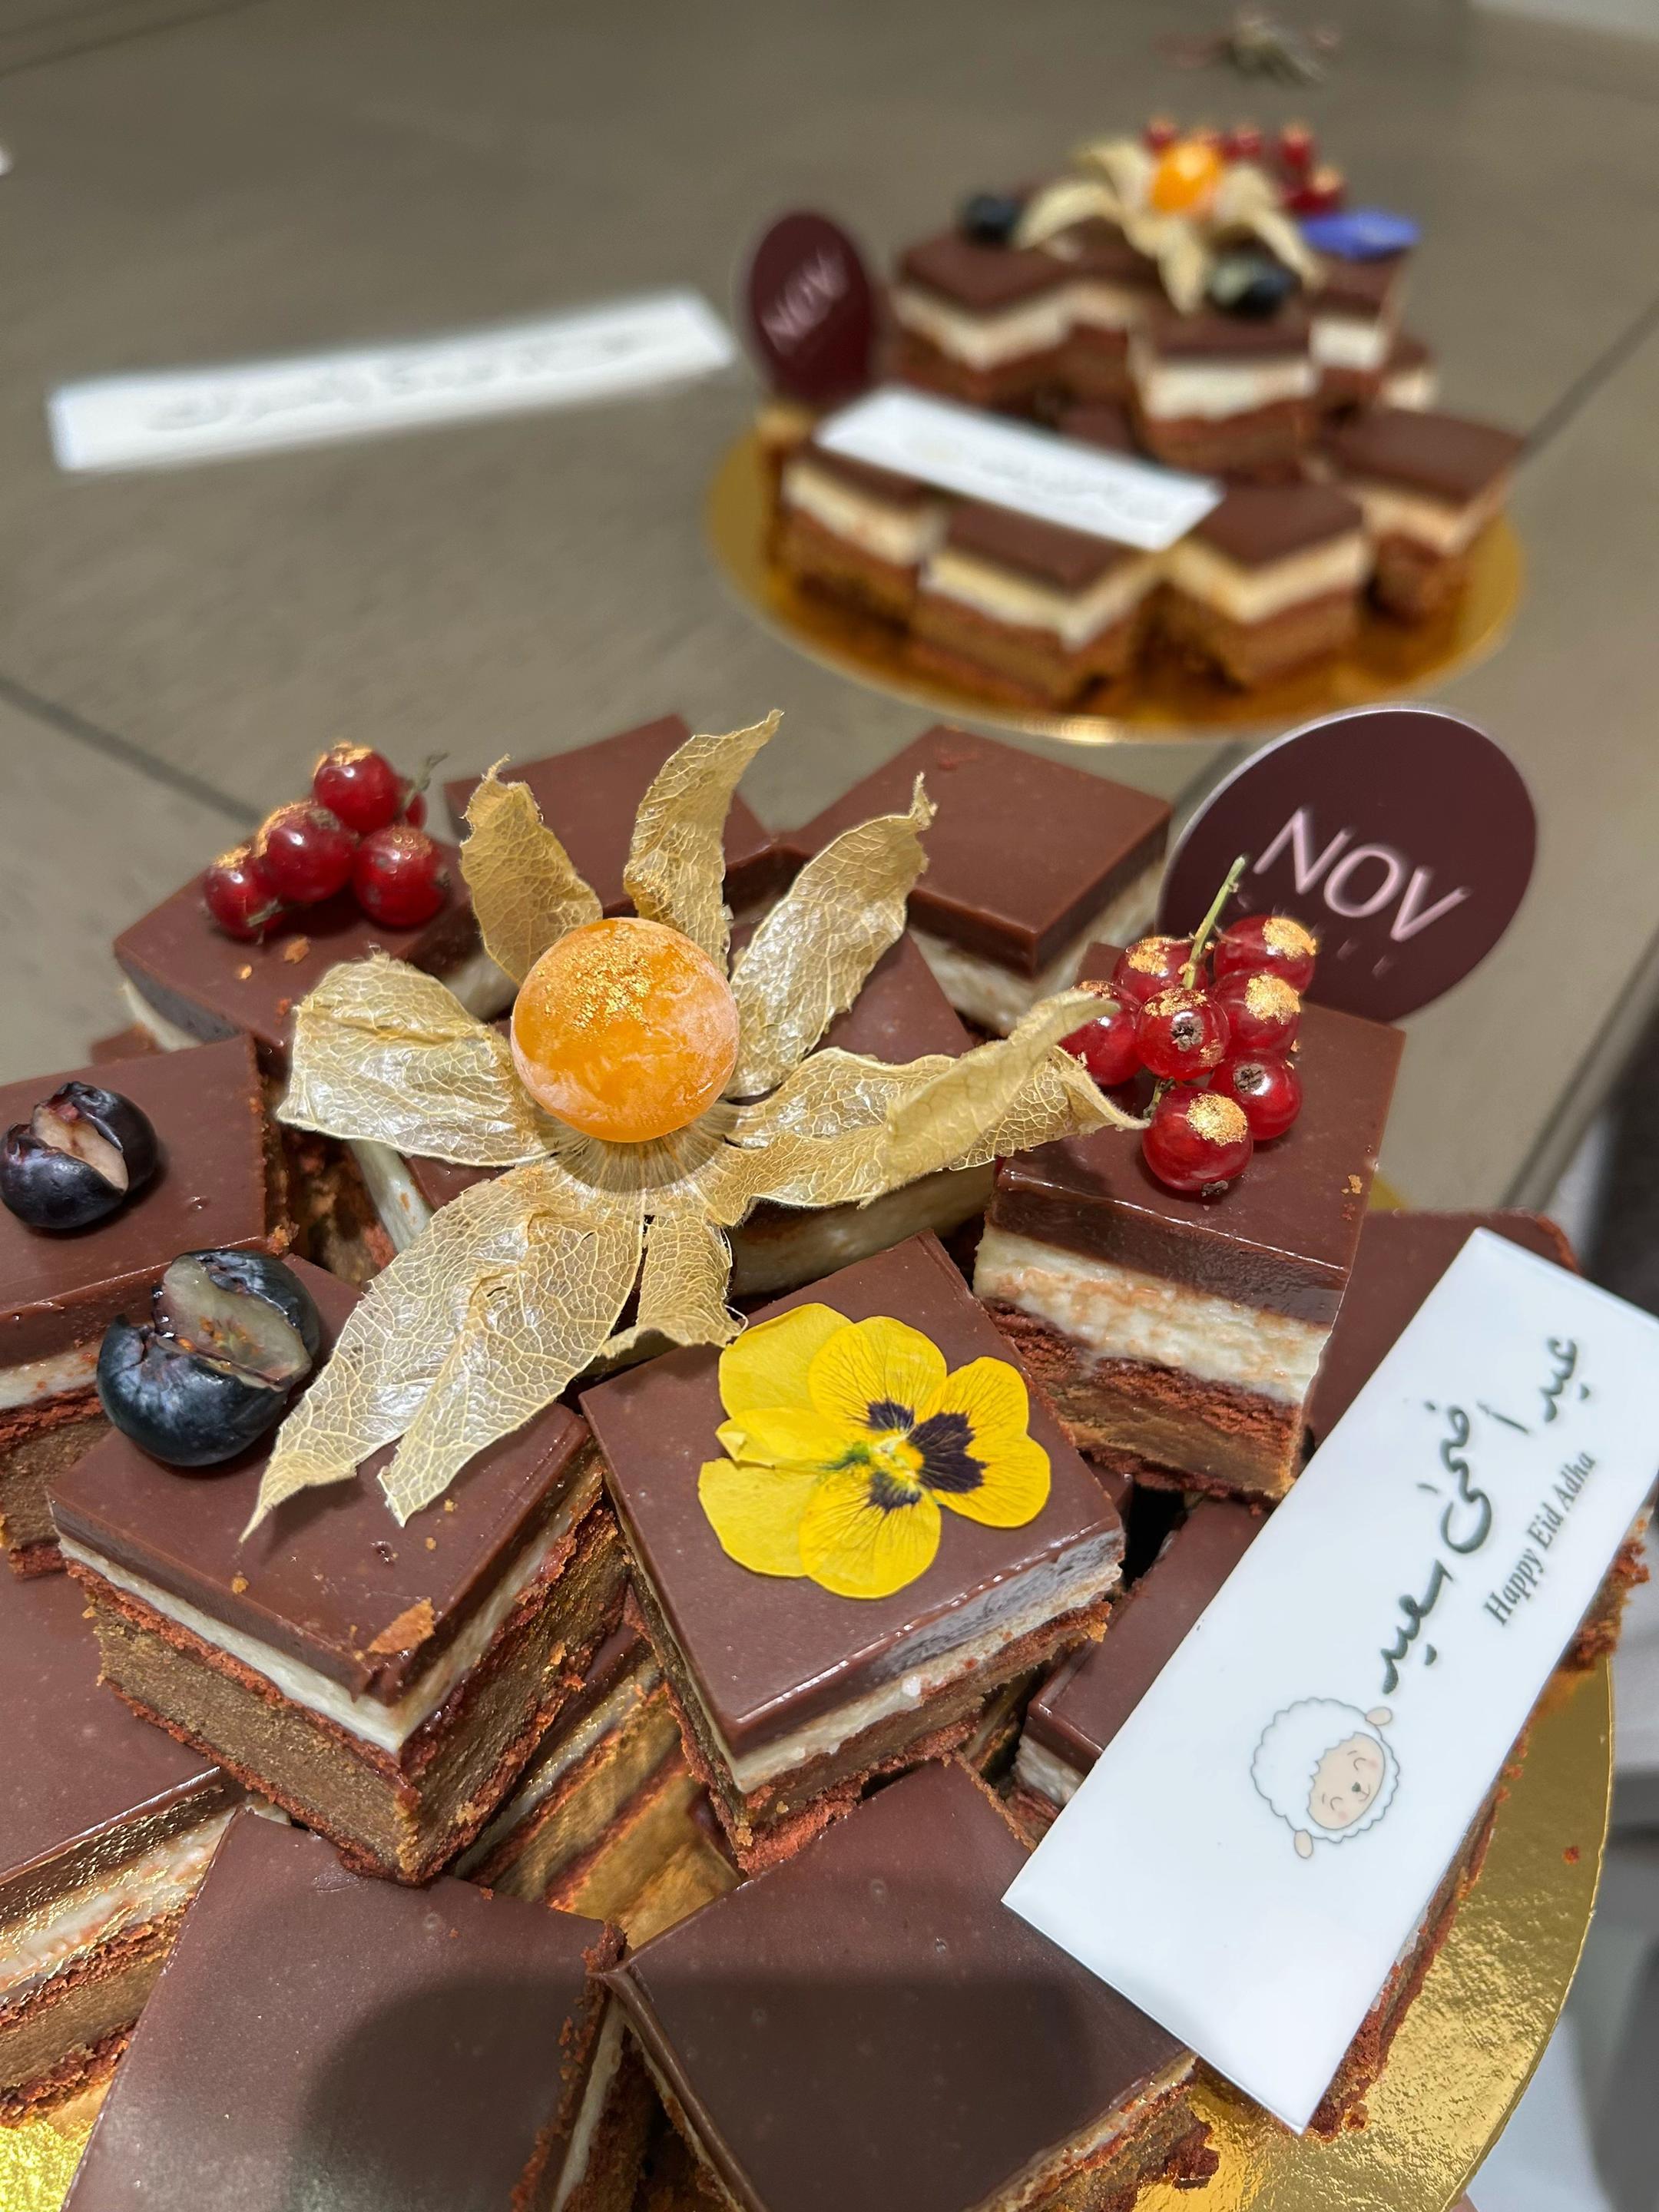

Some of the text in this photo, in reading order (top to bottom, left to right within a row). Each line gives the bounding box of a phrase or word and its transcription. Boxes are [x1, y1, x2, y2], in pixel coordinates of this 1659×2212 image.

[1253, 806, 1469, 942] NOV
[1539, 1337, 1590, 1422] عيد
[1483, 1452, 1595, 1626] Happy Eid Adha
[1381, 1558, 1453, 1694] سعيد
